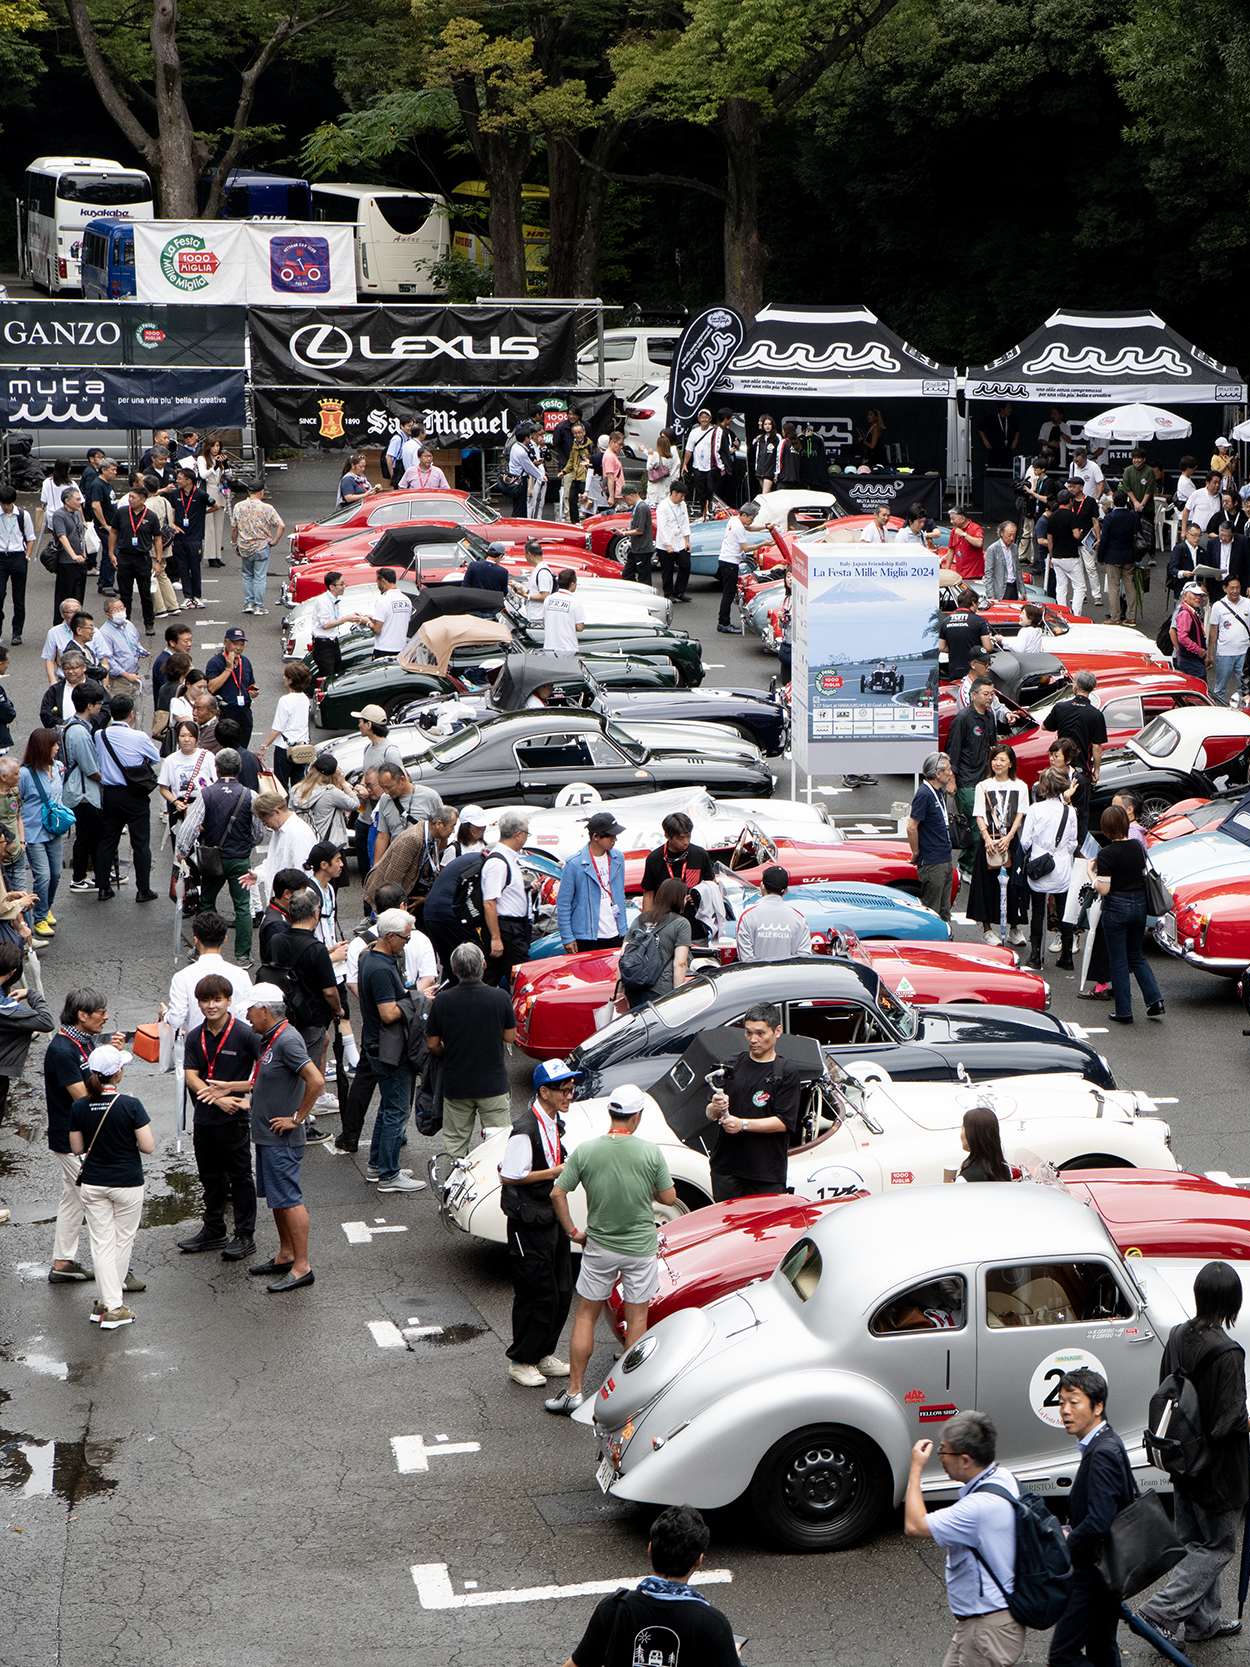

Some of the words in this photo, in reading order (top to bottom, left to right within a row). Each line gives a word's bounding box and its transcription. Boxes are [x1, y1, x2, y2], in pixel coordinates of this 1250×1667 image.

[174, 236, 201, 251] Festa
[181, 264, 212, 272] MIGLIA
[162, 259, 176, 282] Mille
[175, 277, 206, 291] Miglia
[4, 320, 121, 345] GANZO
[360, 336, 539, 359] LEXUS
[9, 377, 105, 394] muta
[146, 396, 159, 404] vita
[175, 396, 192, 404] bella
[200, 396, 227, 404] creativa
[541, 400, 565, 410] Festa
[367, 408, 402, 435] Sa
[422, 408, 511, 439] Miguel
[813, 568, 825, 577] La
[828, 568, 852, 577] Festa
[855, 568, 877, 577] Mille
[880, 568, 908, 579] Miglia
[911, 568, 935, 577] 2024
[904, 1389, 925, 1400] MAC
[919, 1409, 942, 1417] FELLOW
[1043, 1413, 1056, 1425] Festa
[1139, 1478, 1158, 1486] Team
